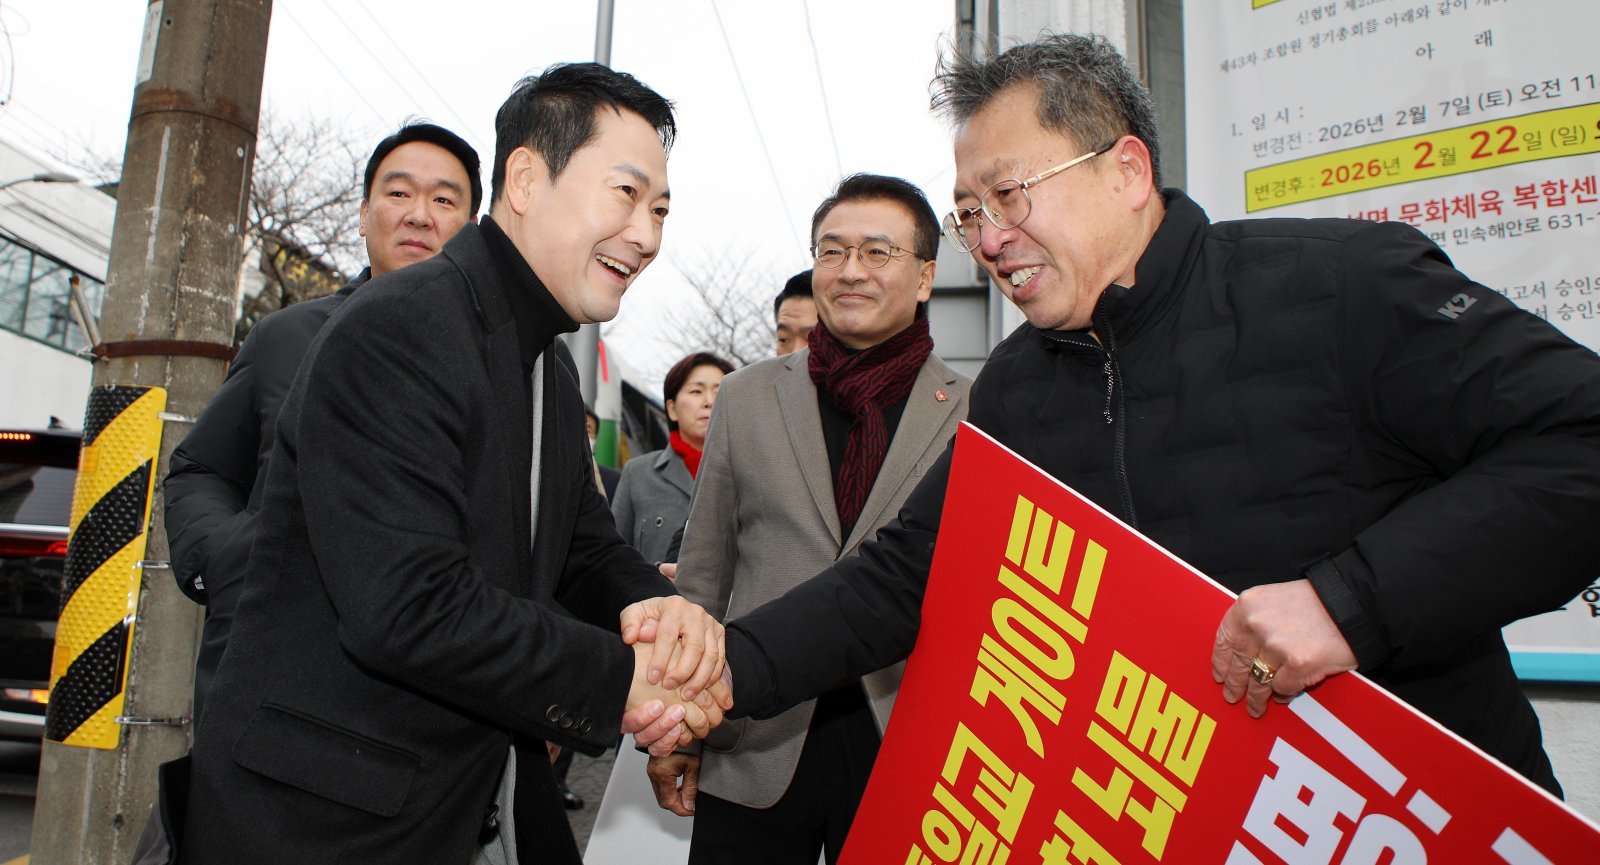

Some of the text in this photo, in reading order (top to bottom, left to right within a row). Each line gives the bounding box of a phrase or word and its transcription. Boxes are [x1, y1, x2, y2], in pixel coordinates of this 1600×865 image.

[1263, 38, 1301, 57] 조합원
[1309, 18, 1378, 49] 정기총회를
[1385, 5, 1430, 27] 아래와
[1438, 0, 1467, 16] 같이
[1415, 29, 1493, 60] 아 래
[1253, 132, 1301, 158] 변경전
[1318, 114, 1384, 142] 2026년
[1395, 104, 1426, 126] 2월
[1438, 95, 1471, 117] 7일
[1478, 88, 1512, 112] (토)
[1520, 78, 1561, 101] 오전
[1570, 73, 1600, 92] 11
[1254, 176, 1304, 201] 변경후
[1320, 157, 1400, 187] 2026년
[1413, 141, 1456, 169] 2월
[1469, 125, 1542, 161] 22일
[1550, 124, 1586, 148] (일)
[1398, 190, 1504, 227] 문화체육
[1512, 175, 1598, 209] 복합센
[1453, 217, 1541, 245] 민속해안로
[1437, 293, 1478, 320] K2
[1557, 301, 1600, 321] 승인
[969, 494, 1108, 760] 게이트
[1071, 650, 1217, 862] 뇌물
[1224, 692, 1453, 865] 명!
[905, 721, 1035, 865] 일교
